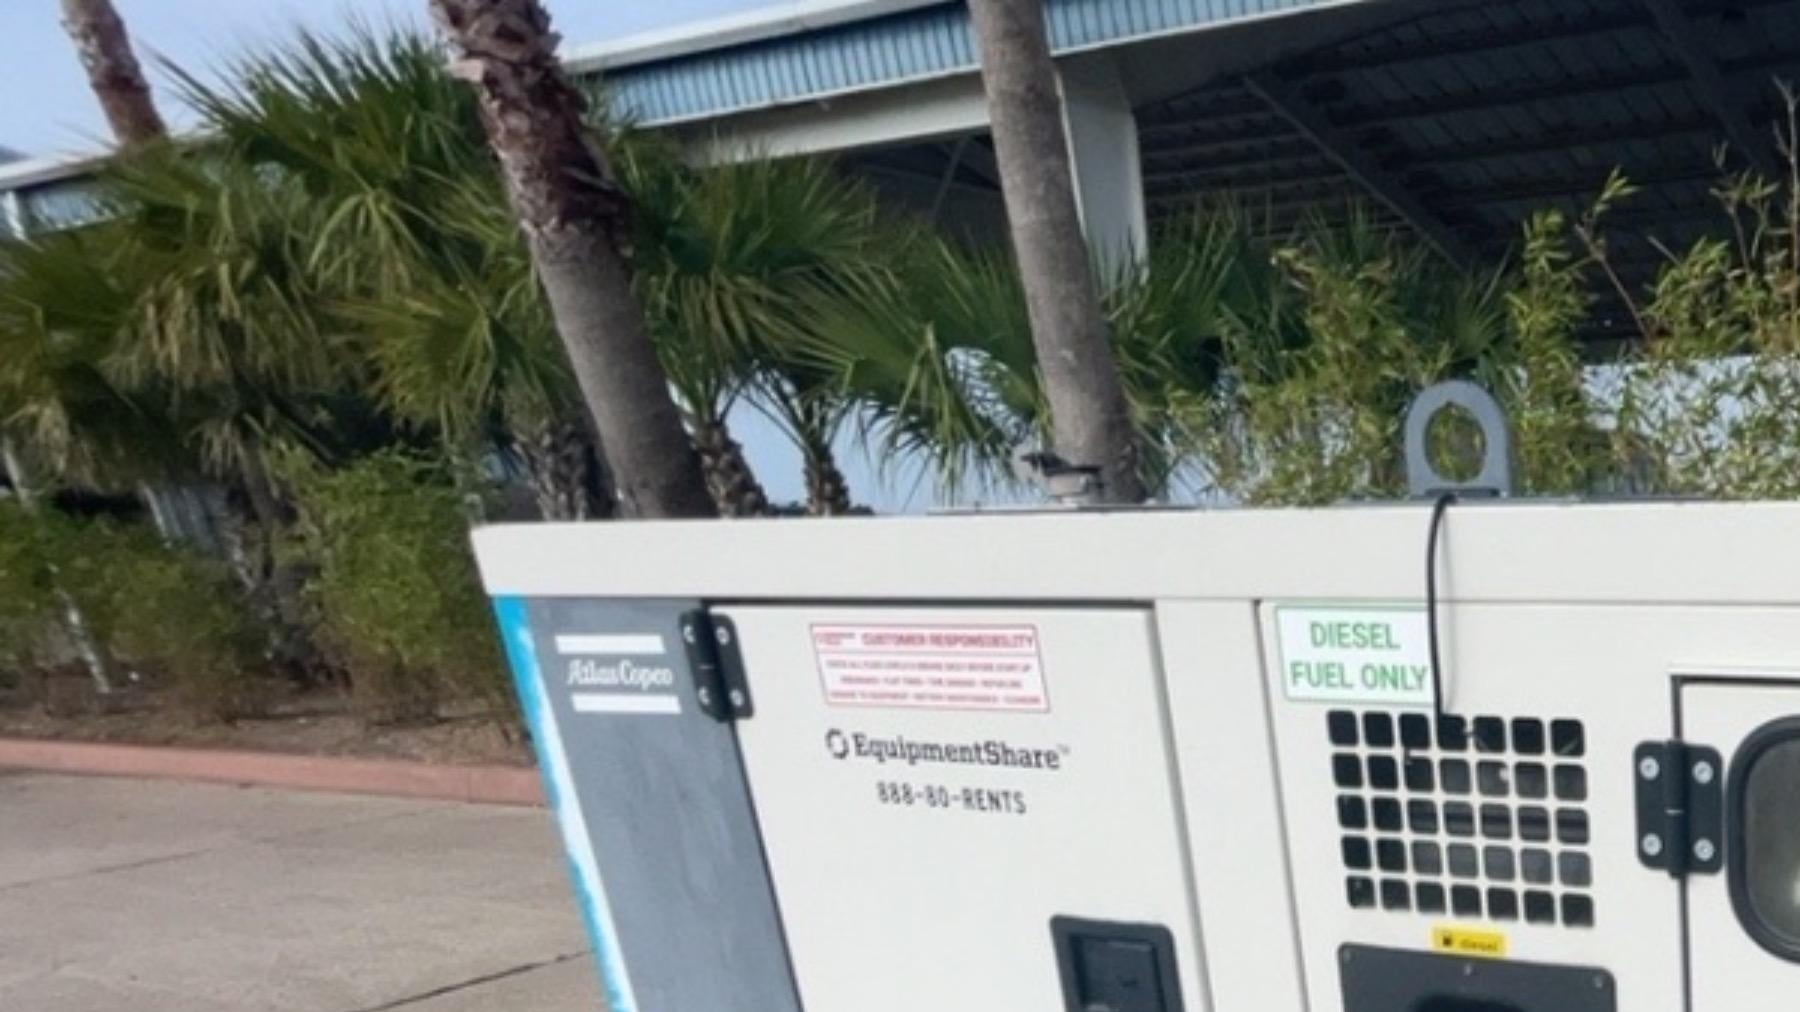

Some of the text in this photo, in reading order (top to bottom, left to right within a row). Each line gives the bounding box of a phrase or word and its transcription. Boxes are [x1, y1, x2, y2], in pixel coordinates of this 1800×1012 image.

[1311, 622, 1401, 650] DIESEL
[1290, 661, 1429, 692] FUEL ONLY
[852, 732, 1061, 770] EquipmentShare
[876, 781, 1028, 815] 888-80-RENTS
